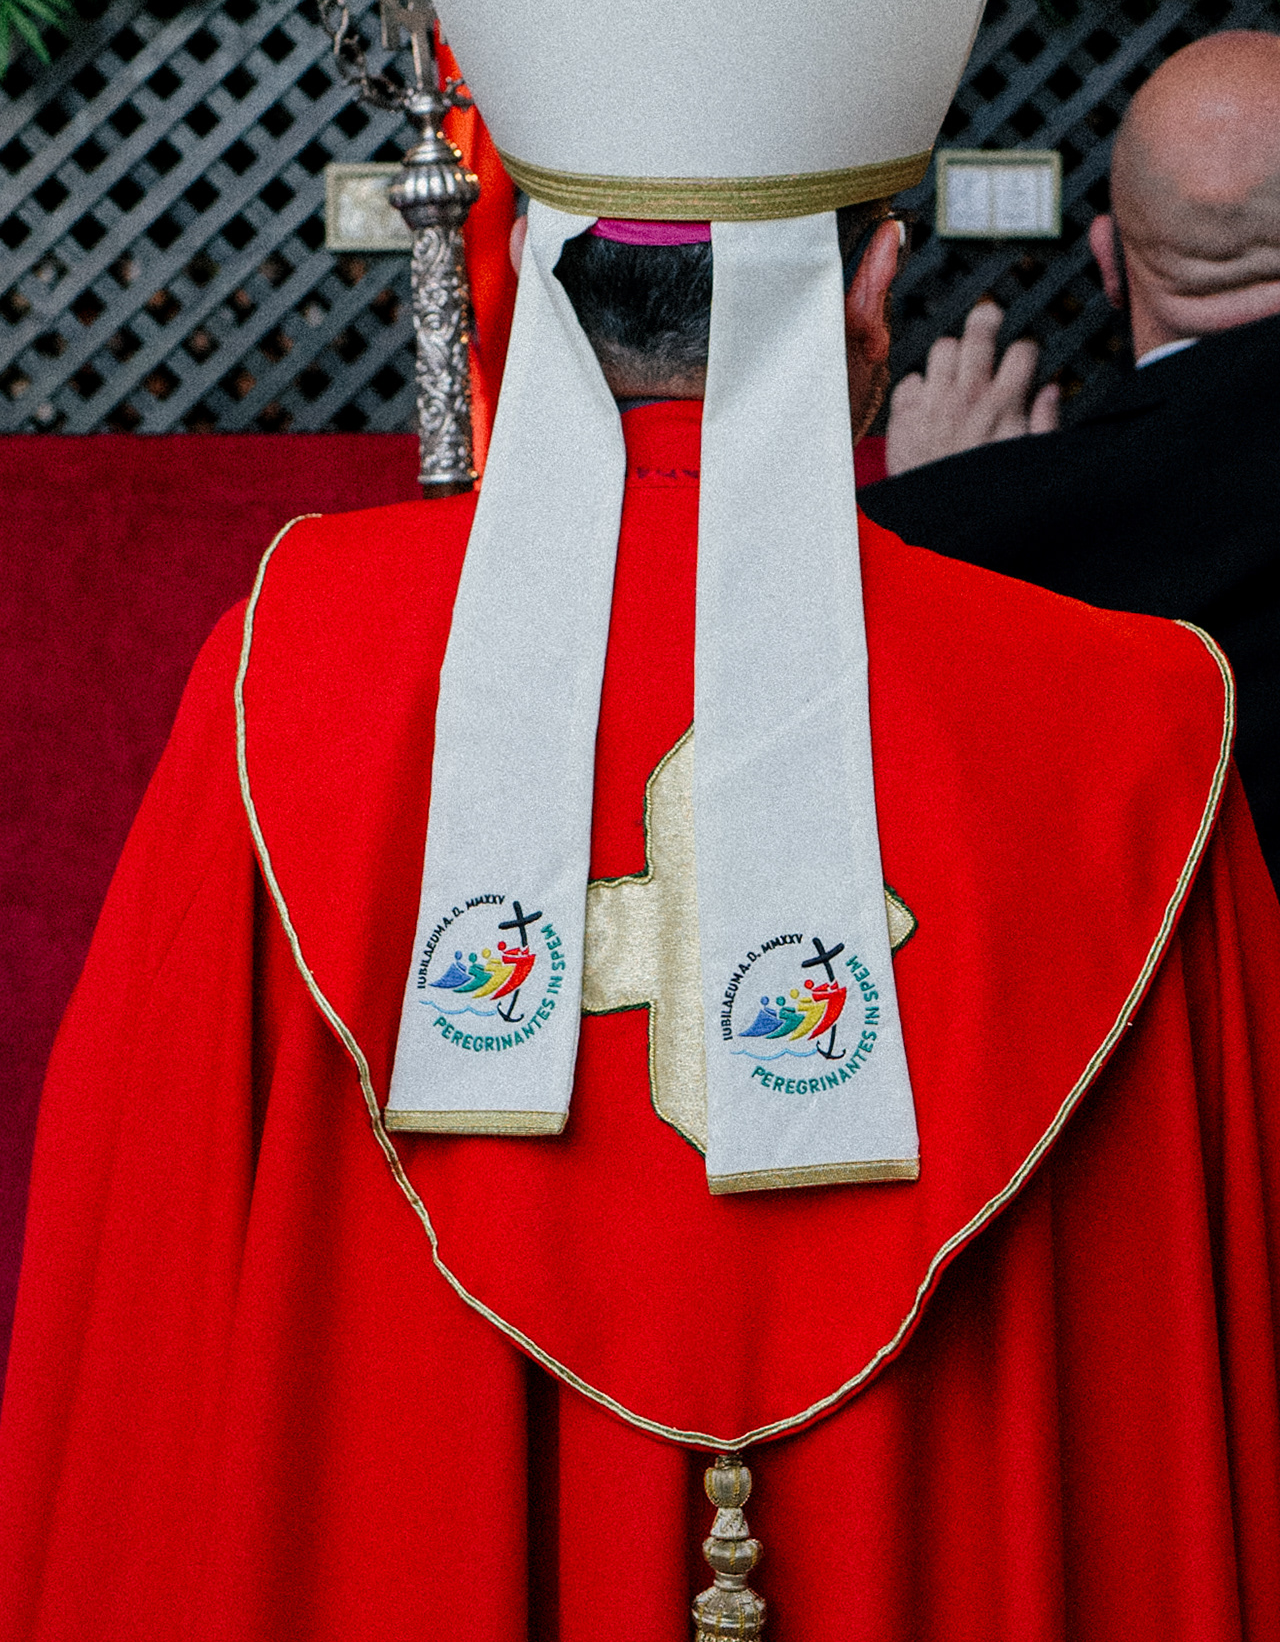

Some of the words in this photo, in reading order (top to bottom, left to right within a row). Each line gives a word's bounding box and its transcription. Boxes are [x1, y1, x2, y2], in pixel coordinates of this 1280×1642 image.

[417, 924, 447, 990] IUBILAEUM
[540, 923, 566, 971] SPEM
[546, 975, 564, 995] IN
[720, 972, 744, 1041] IUBILAEUM
[761, 933, 804, 954] MMXXV
[845, 955, 880, 1002] SPEM
[432, 997, 556, 1053] PEREGRINANTES
[864, 1005, 880, 1026] IN
[750, 1029, 878, 1095] PEREGRINANTES
